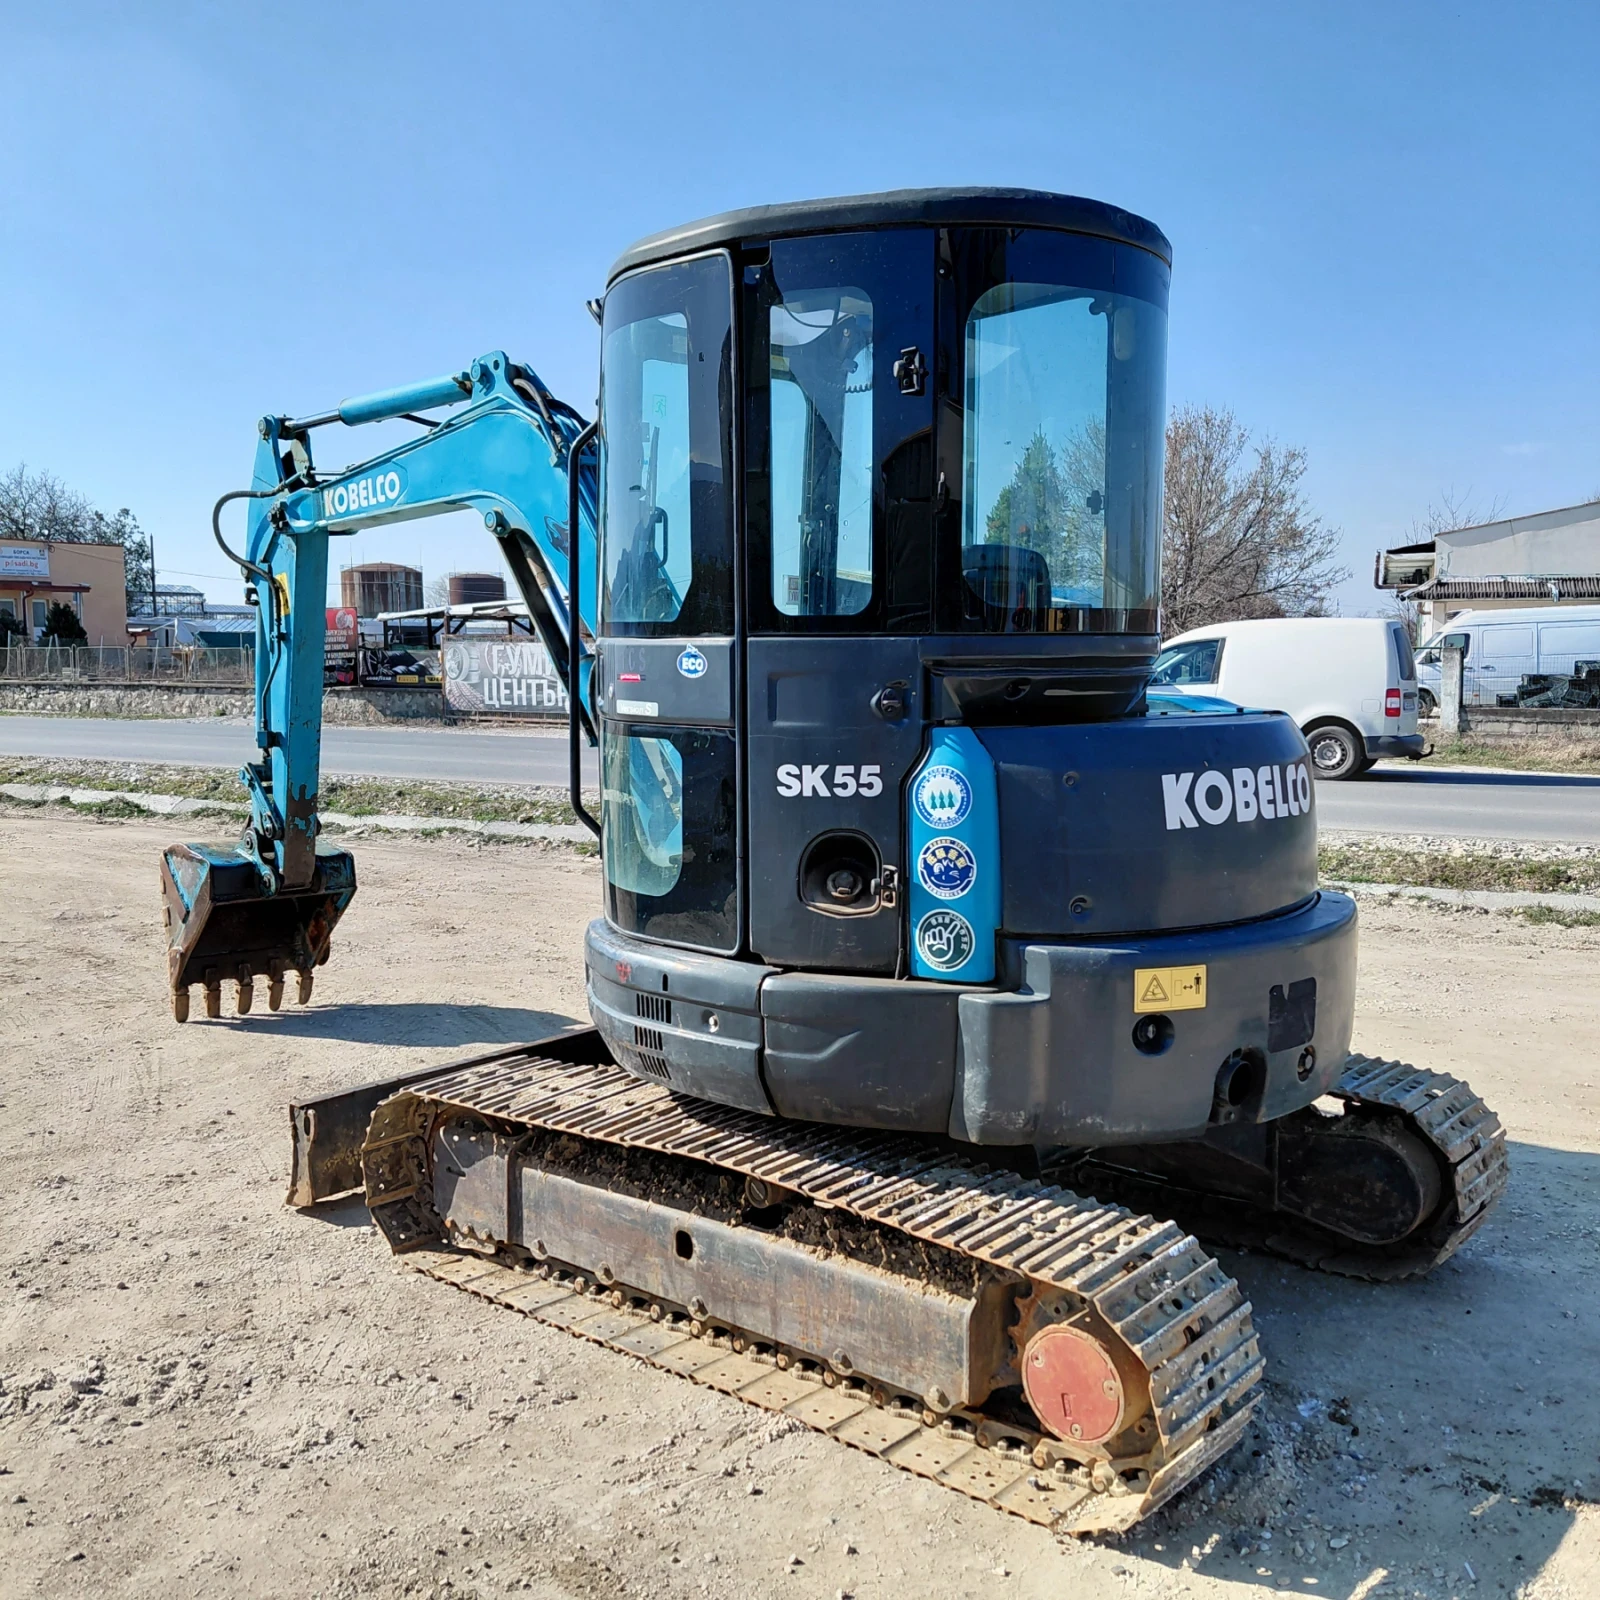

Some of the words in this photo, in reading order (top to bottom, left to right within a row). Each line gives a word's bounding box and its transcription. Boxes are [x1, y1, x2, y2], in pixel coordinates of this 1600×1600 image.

[323, 471, 400, 517] KOBELCO
[682, 657, 704, 671] ECO
[620, 703, 644, 714] Version
[776, 763, 883, 798] SK55
[1161, 763, 1311, 831] KOBELCO
